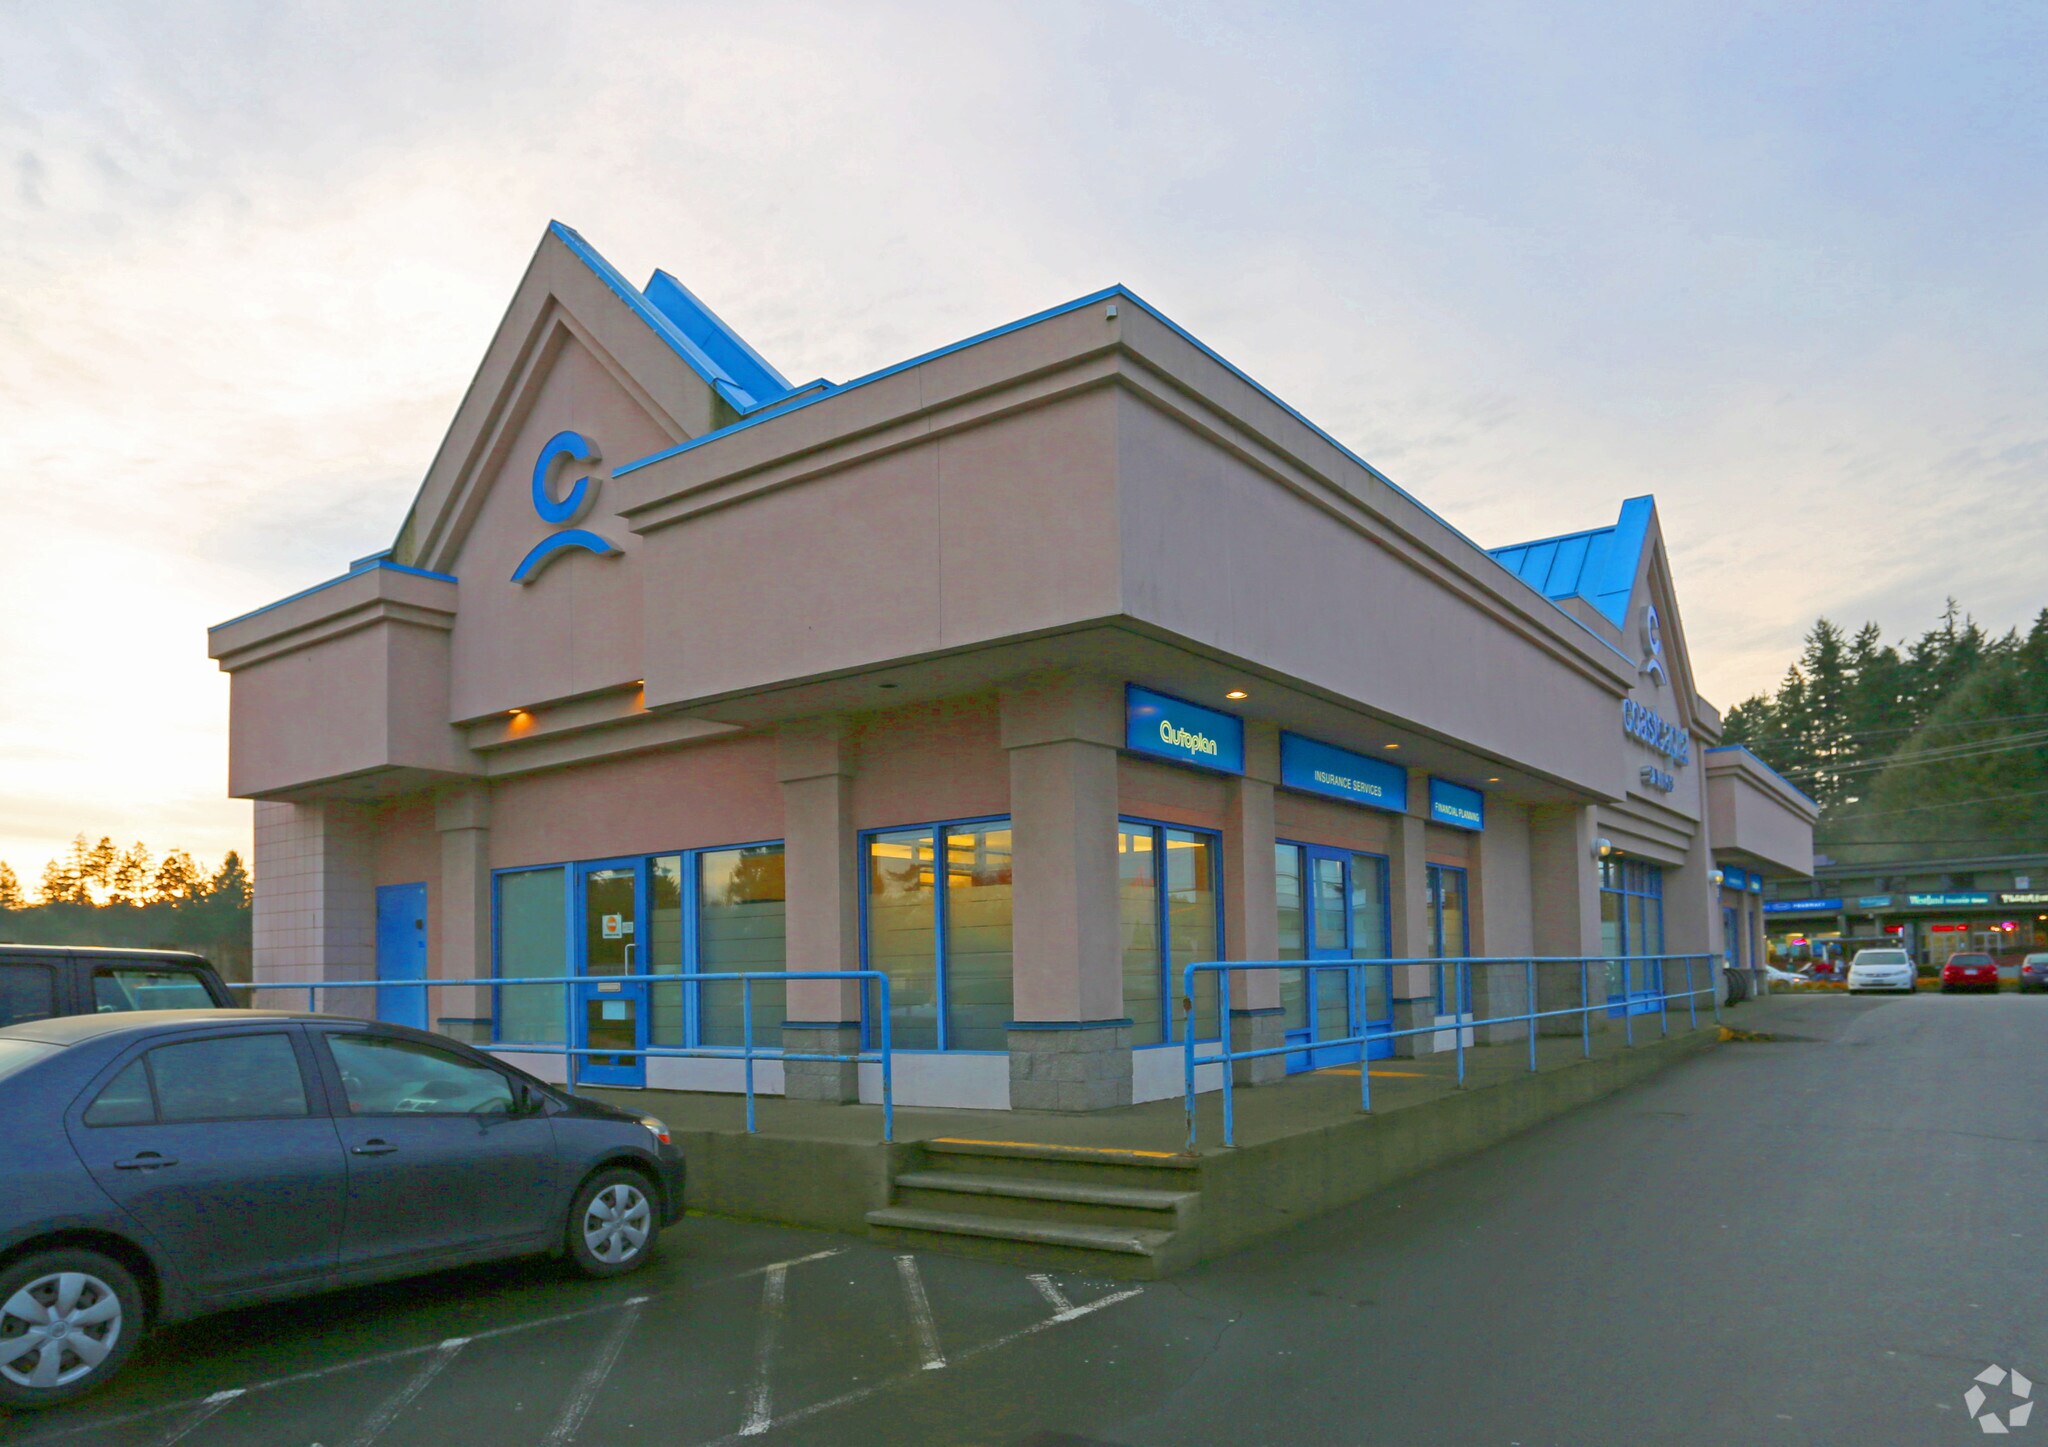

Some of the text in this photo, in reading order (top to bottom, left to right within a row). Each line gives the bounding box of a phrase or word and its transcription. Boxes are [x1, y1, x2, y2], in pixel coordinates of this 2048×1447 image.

[1159, 719, 1218, 756] Autoplan
[1314, 770, 1382, 798] INSURANCE SERVICES
[1434, 801, 1480, 823] FINANCIAL PLANNING
